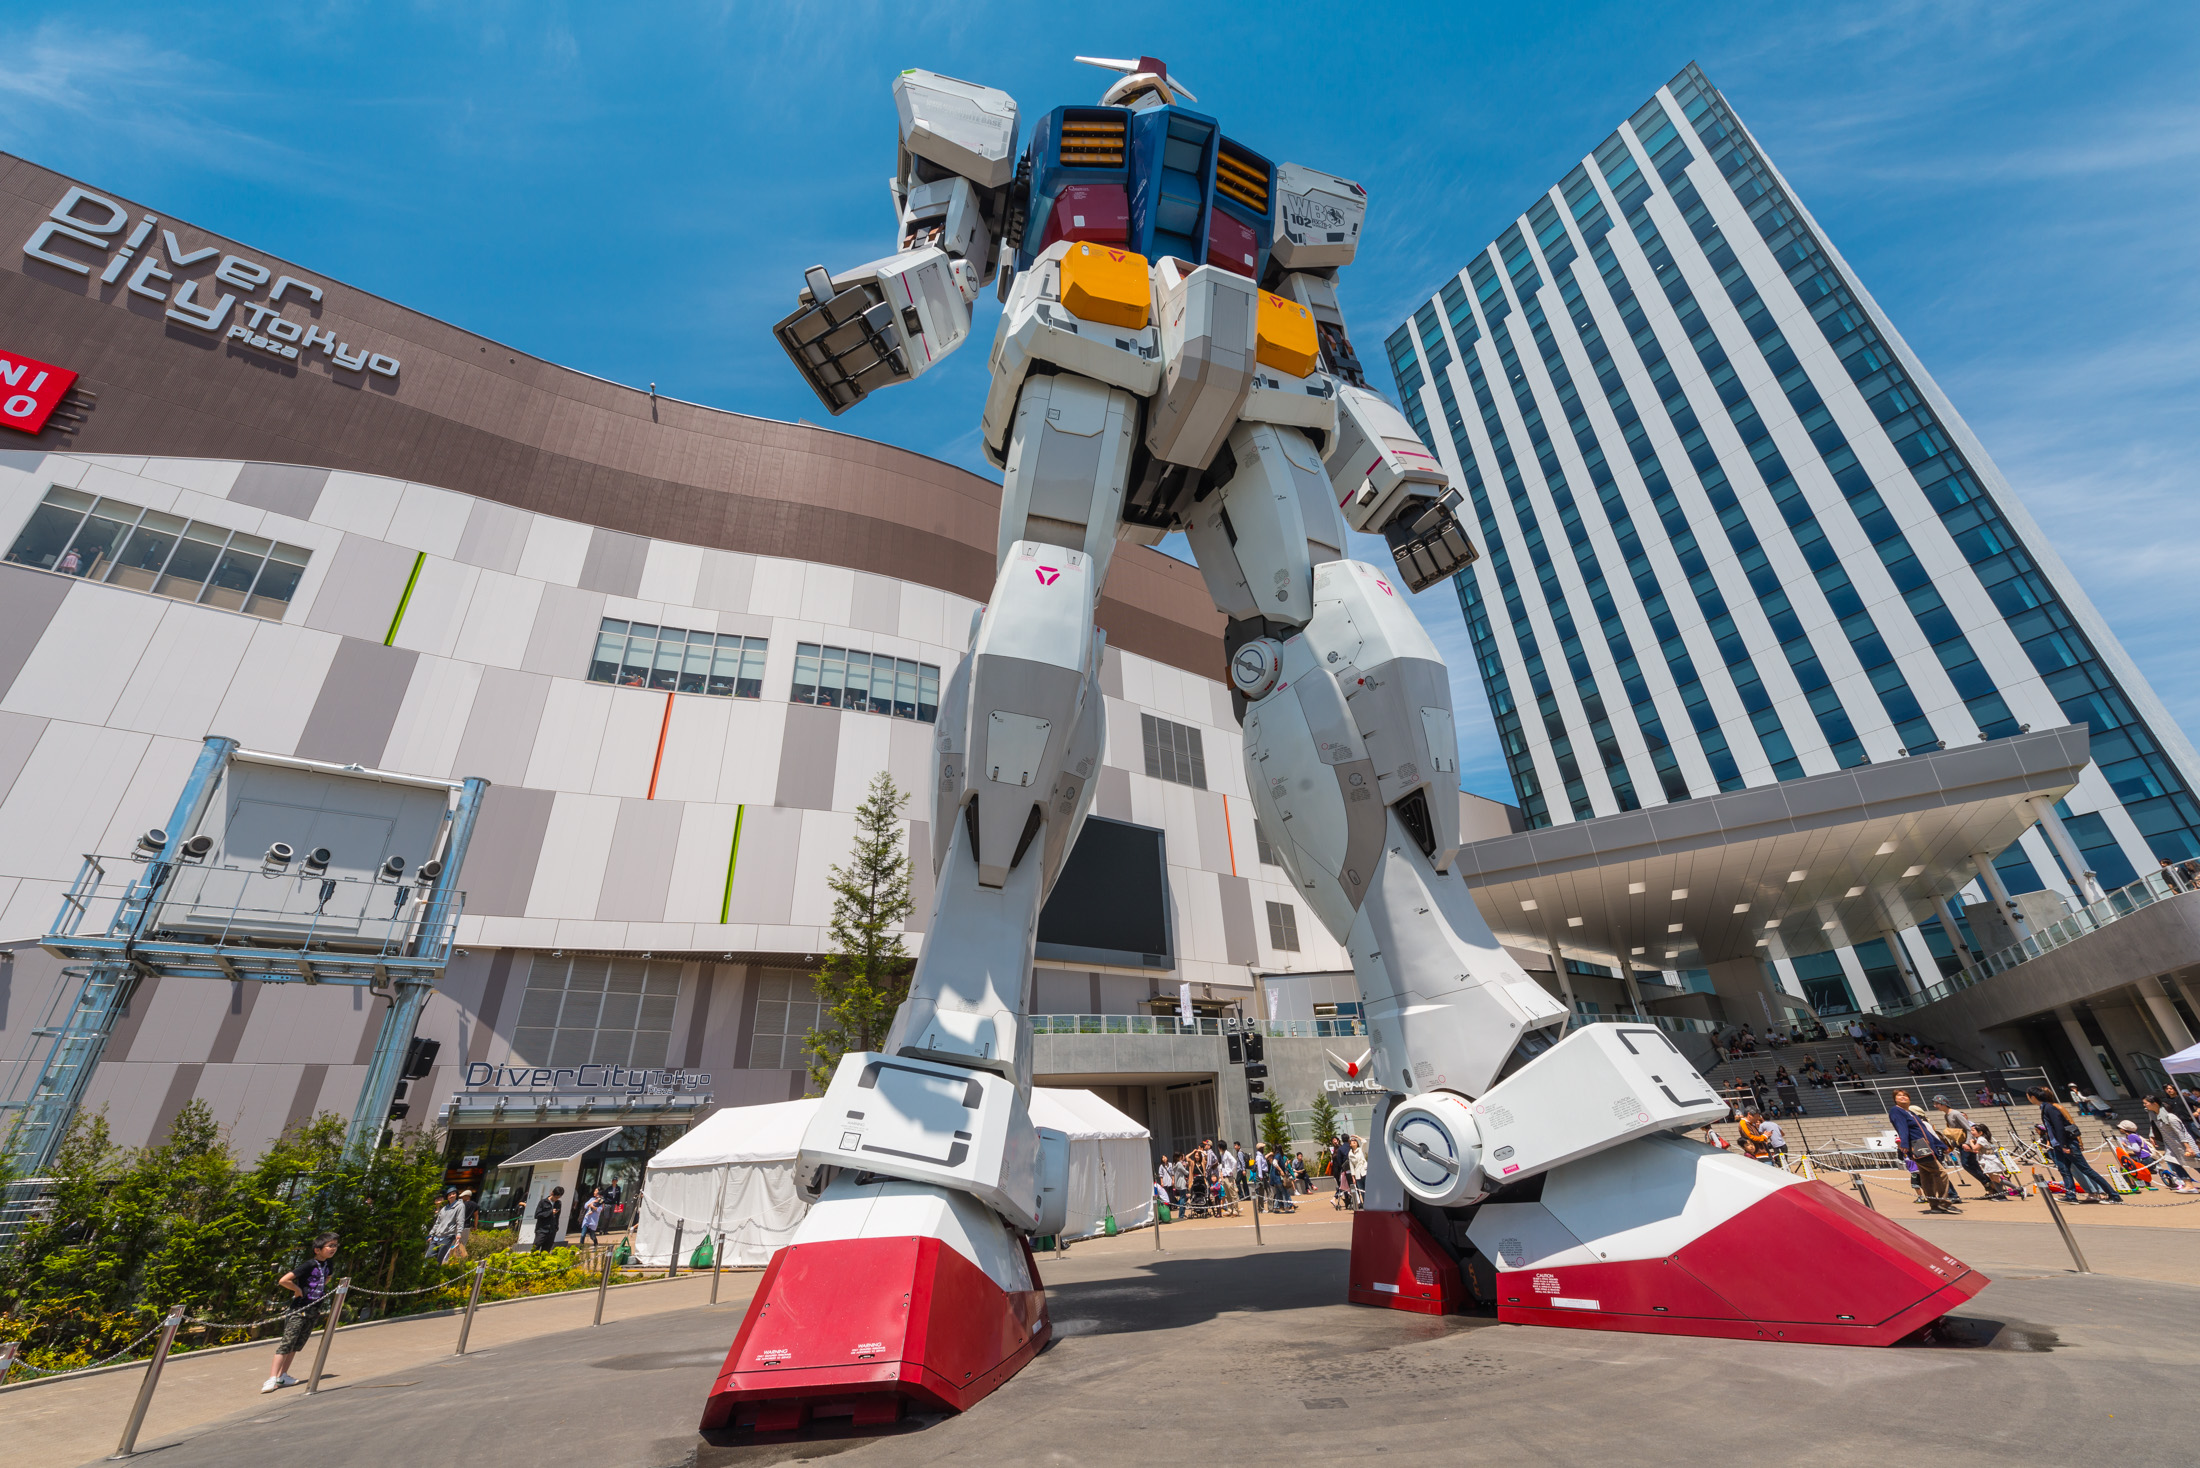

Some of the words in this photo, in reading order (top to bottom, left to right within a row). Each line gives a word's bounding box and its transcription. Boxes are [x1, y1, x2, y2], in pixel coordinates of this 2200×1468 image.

[1291, 214, 1312, 228] 102
[49, 185, 323, 303] Diver
[23, 221, 236, 332] City
[227, 324, 299, 360] Plaza
[464, 1061, 649, 1095] DiverCity
[1875, 1139, 1882, 1147] 2
